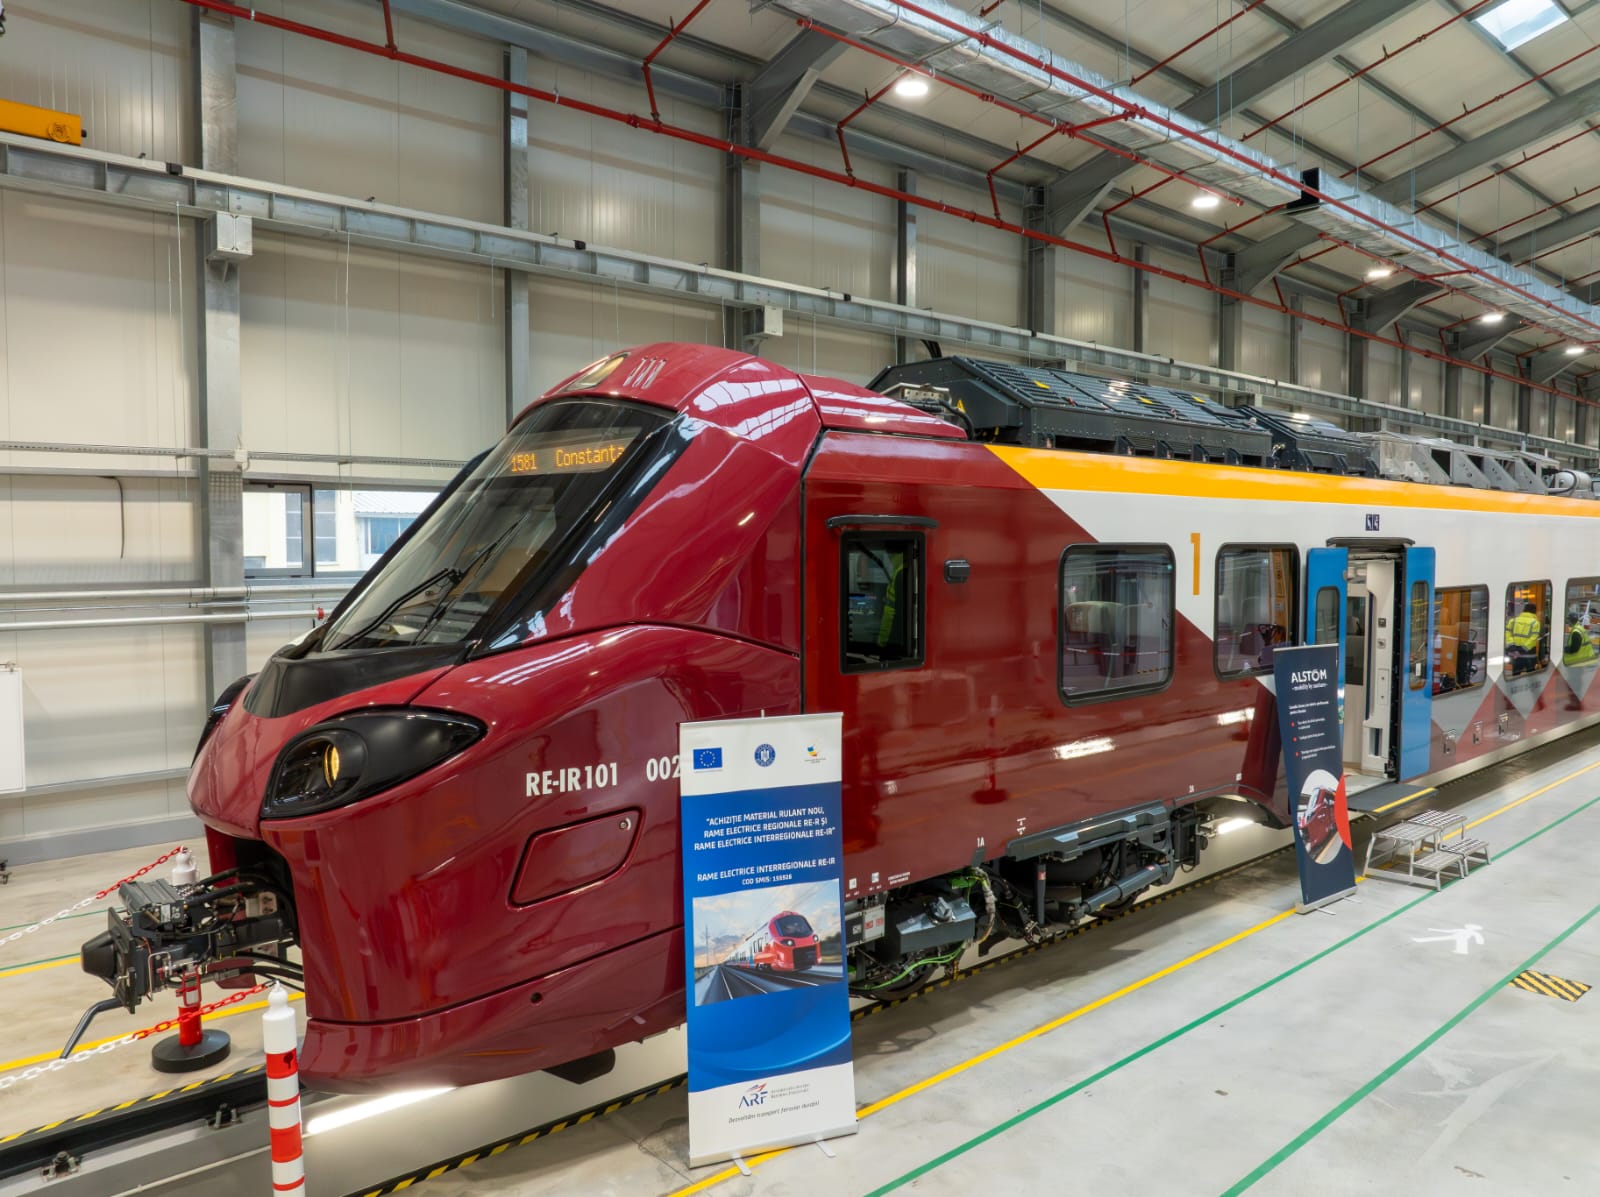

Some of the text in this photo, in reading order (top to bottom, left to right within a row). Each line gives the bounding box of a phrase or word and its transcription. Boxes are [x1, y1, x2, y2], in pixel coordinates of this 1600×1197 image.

[512, 453, 537, 472] 1581
[1190, 533, 1200, 596] 1
[646, 755, 681, 782] 002
[744, 811, 777, 821] MATERIAL
[779, 808, 807, 818] RULANT
[808, 806, 825, 816] NOU,
[704, 828, 725, 838] RAME
[726, 824, 761, 835] ELECTRICE
[763, 820, 802, 831] REGIONALE
[804, 818, 820, 827] RE-R
[694, 841, 716, 851] RAME
[717, 836, 752, 848] ELECTRICE
[754, 830, 814, 843] INTERREGIONALE
[697, 857, 836, 881] RAME ELECTRICE INTERREGIONALE RE-IR
[742, 878, 754, 886] COD
[739, 1090, 768, 1109] ARF
